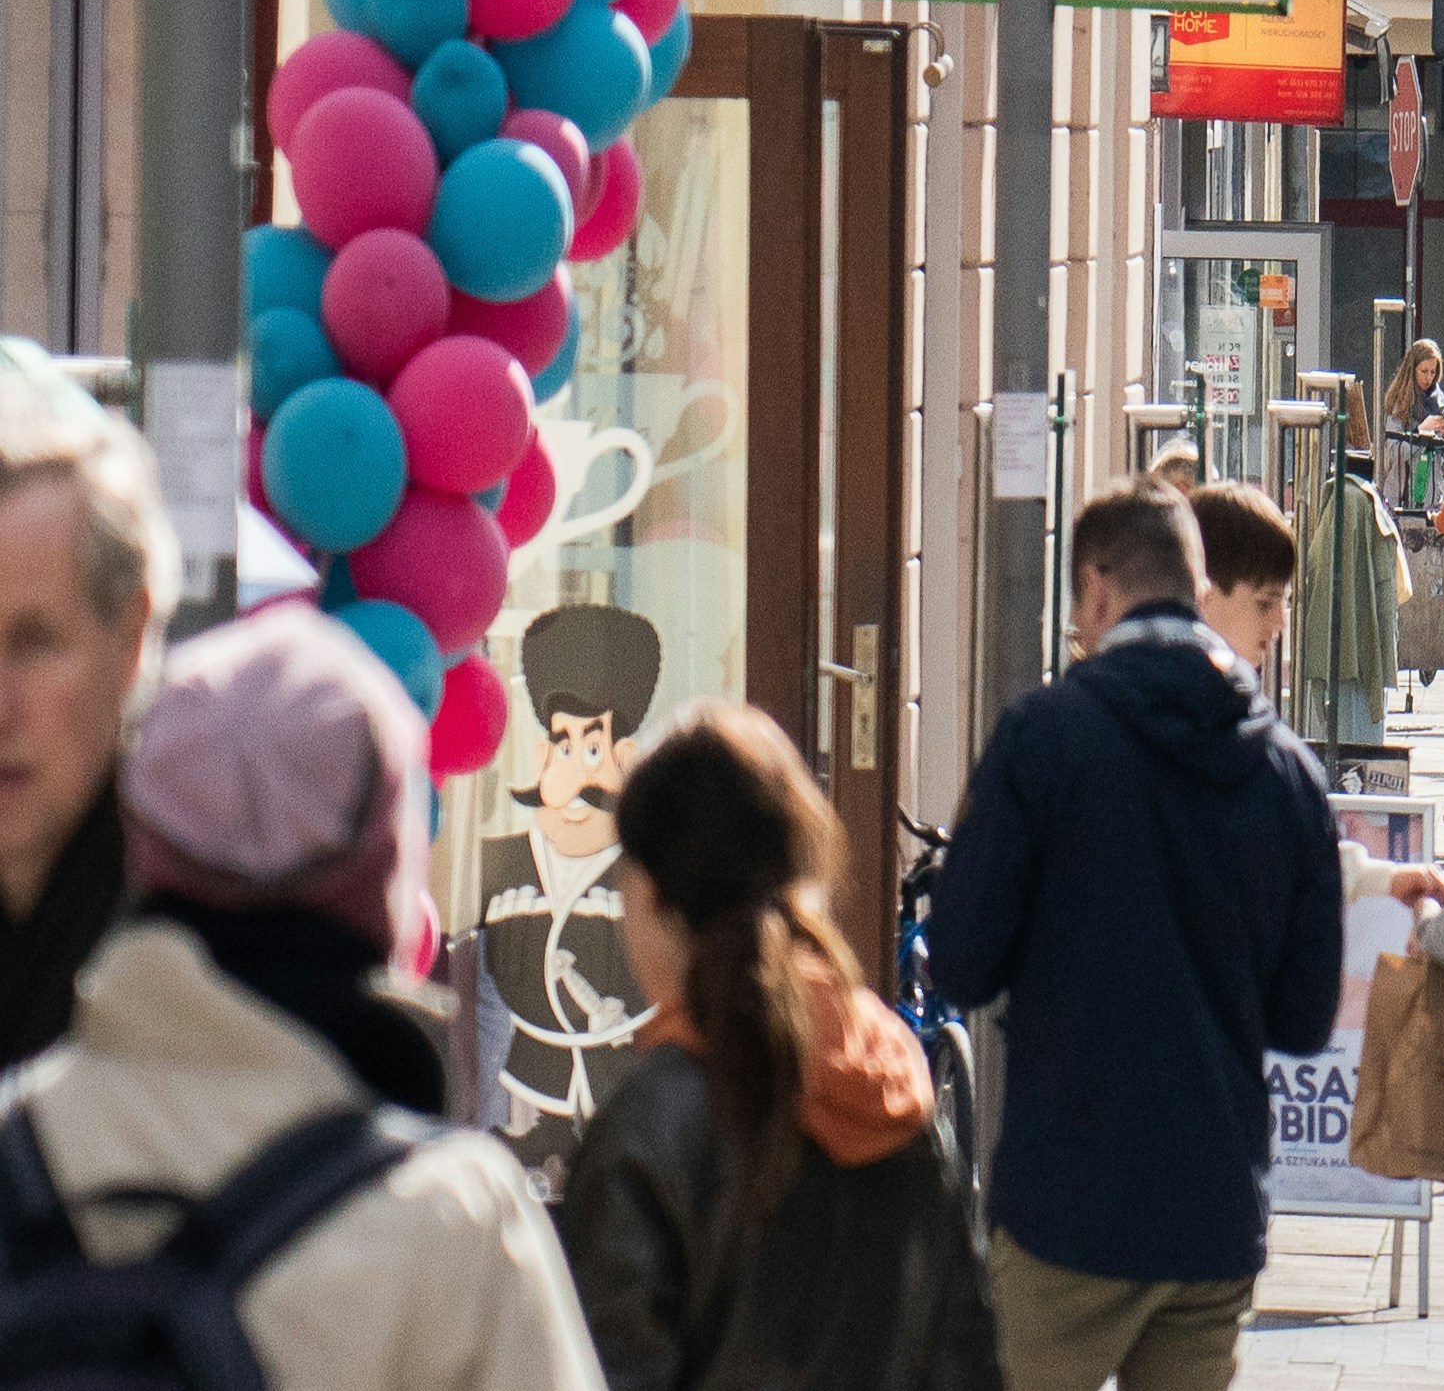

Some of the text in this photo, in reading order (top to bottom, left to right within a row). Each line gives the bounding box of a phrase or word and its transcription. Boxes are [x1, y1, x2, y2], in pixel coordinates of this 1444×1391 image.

[1174, 18, 1217, 34] HOME
[1392, 111, 1416, 152] STOP
[1270, 1104, 1348, 1144] BID
